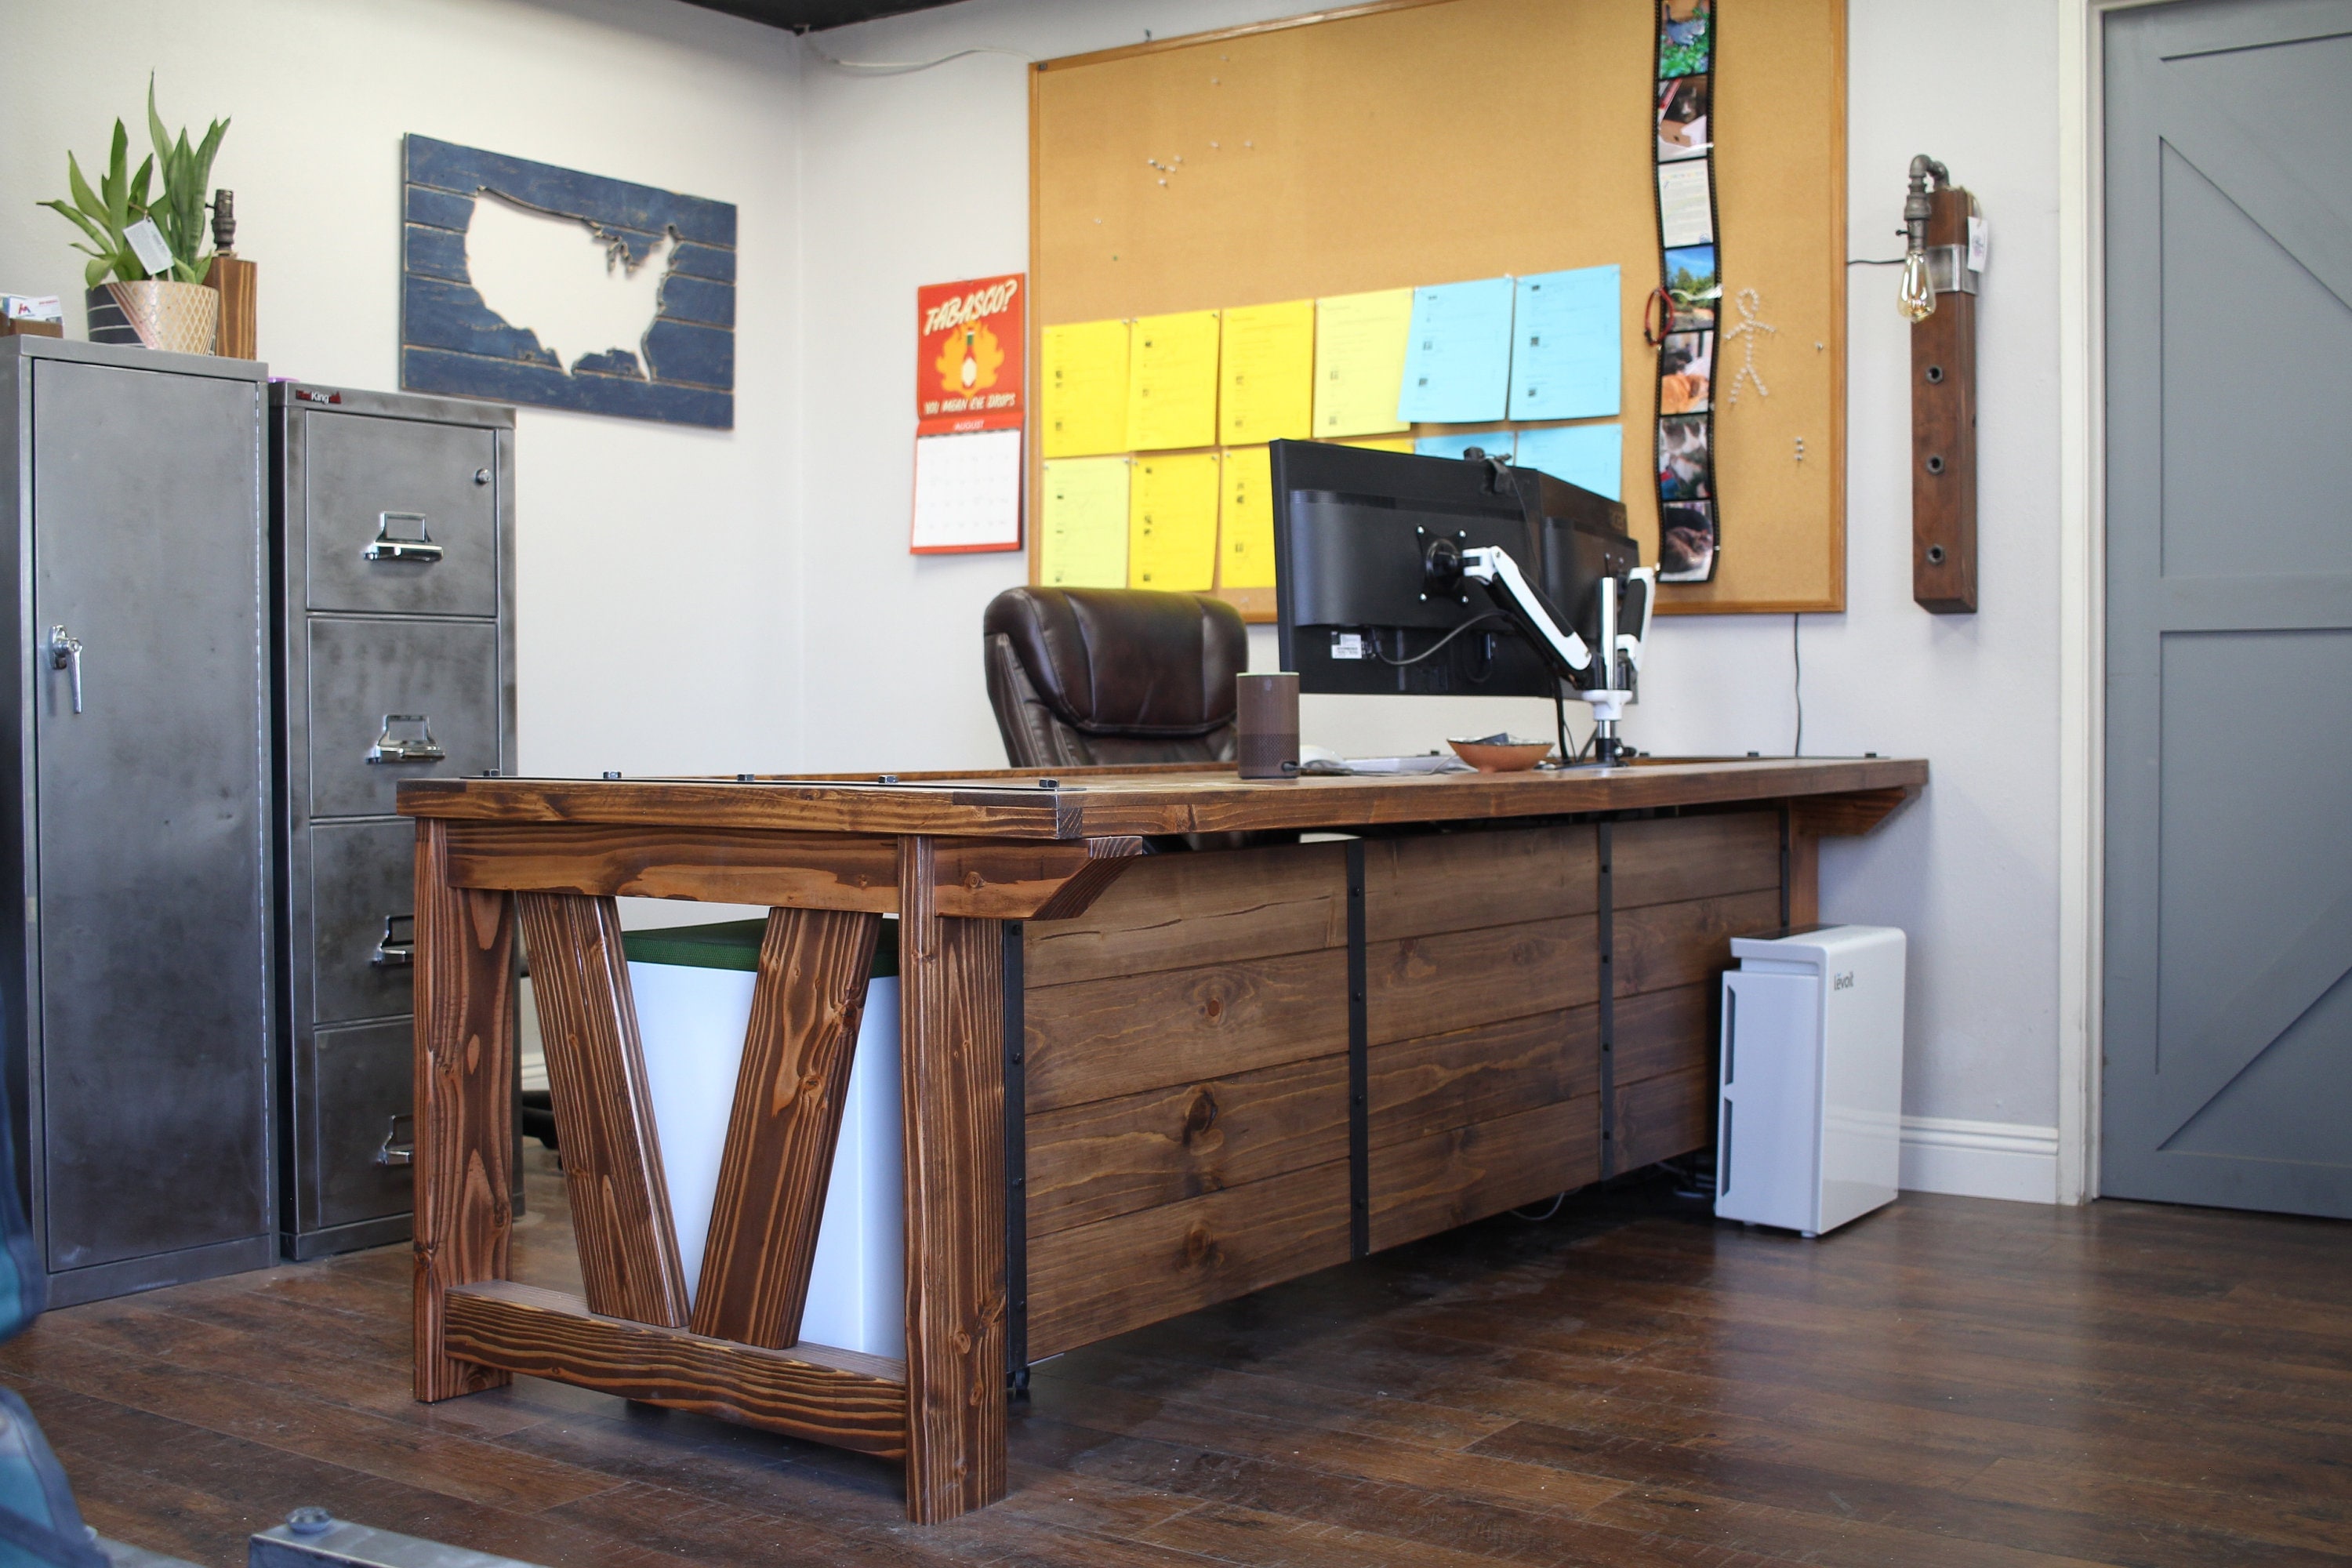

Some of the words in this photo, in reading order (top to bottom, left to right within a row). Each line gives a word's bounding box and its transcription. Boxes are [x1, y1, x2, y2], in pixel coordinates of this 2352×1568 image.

[924, 279, 1018, 336] TABASCO?
[942, 398, 968, 412] MEAN
[986, 393, 1015, 408] DROPS
[954, 419, 984, 431] AUGUST
